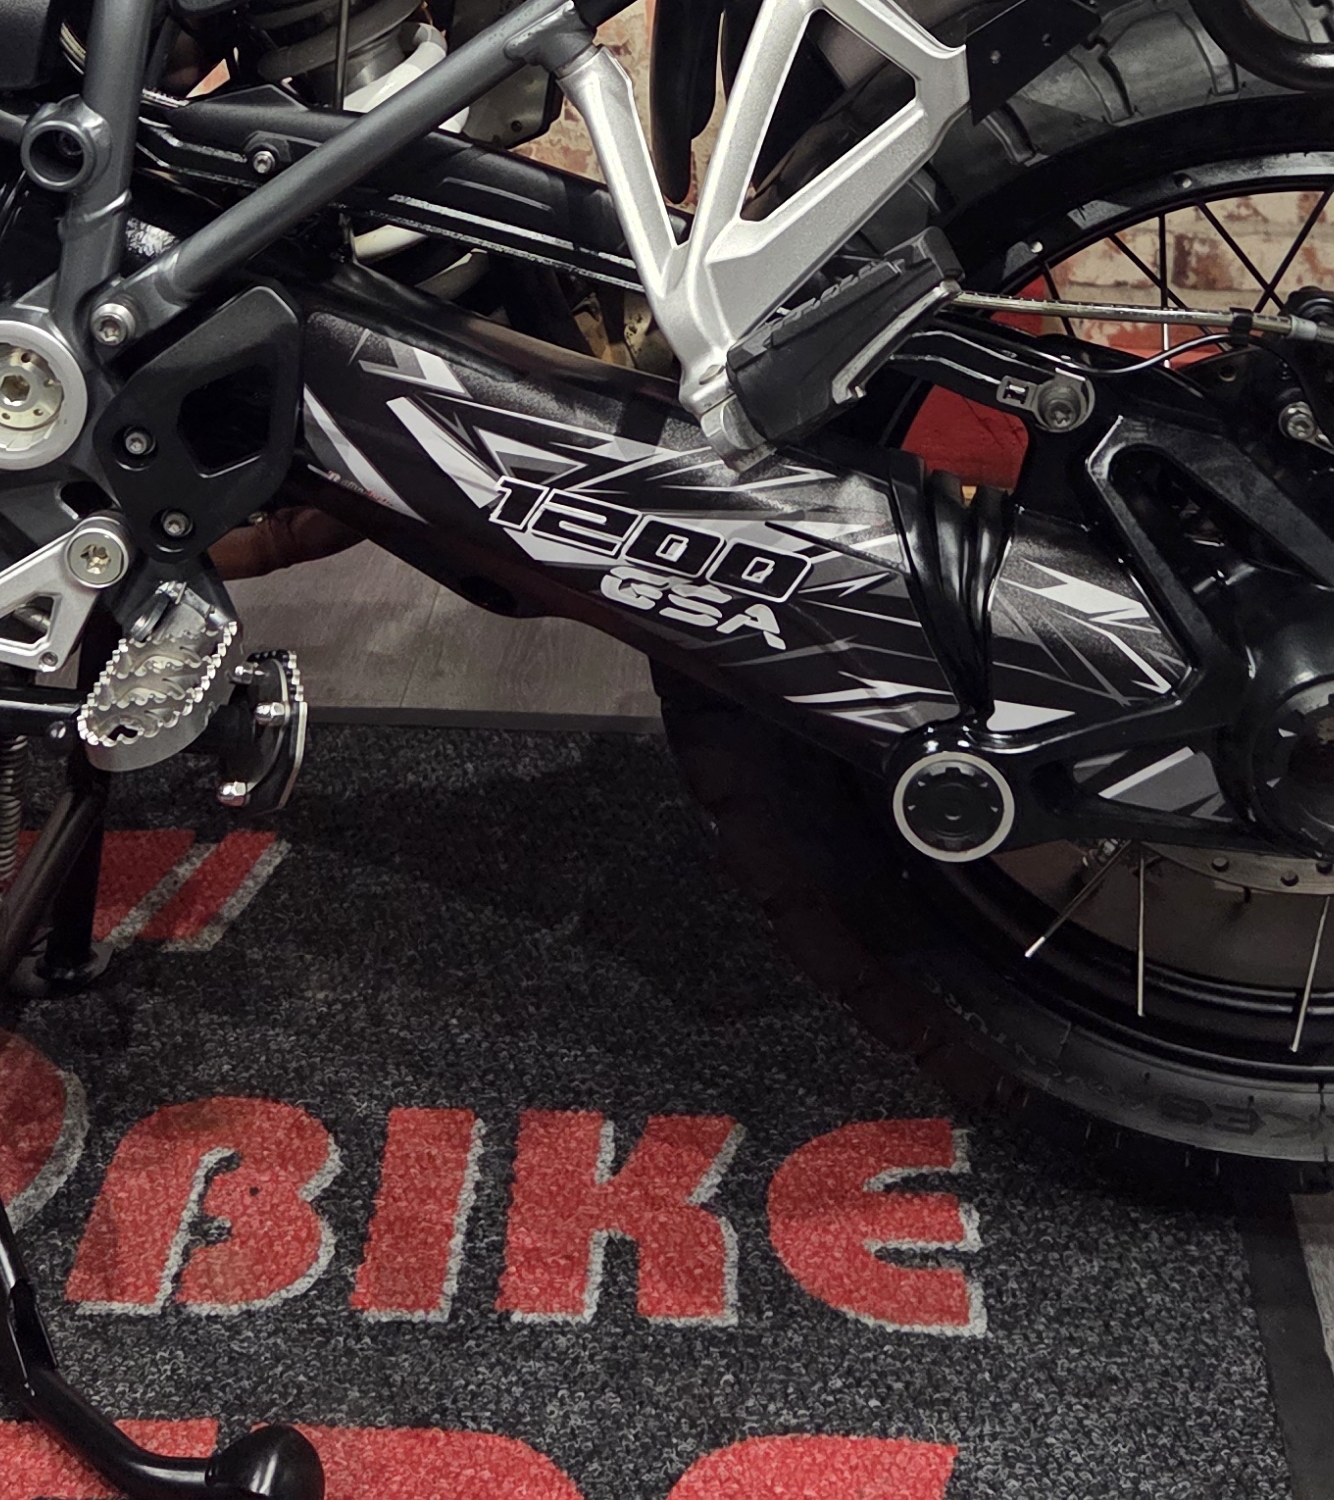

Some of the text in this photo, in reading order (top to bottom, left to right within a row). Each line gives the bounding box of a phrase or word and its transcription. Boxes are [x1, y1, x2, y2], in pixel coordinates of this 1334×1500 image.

[489, 475, 813, 603] 1200
[600, 566, 787, 650] GSA
[65, 1095, 988, 1337] BIKE
